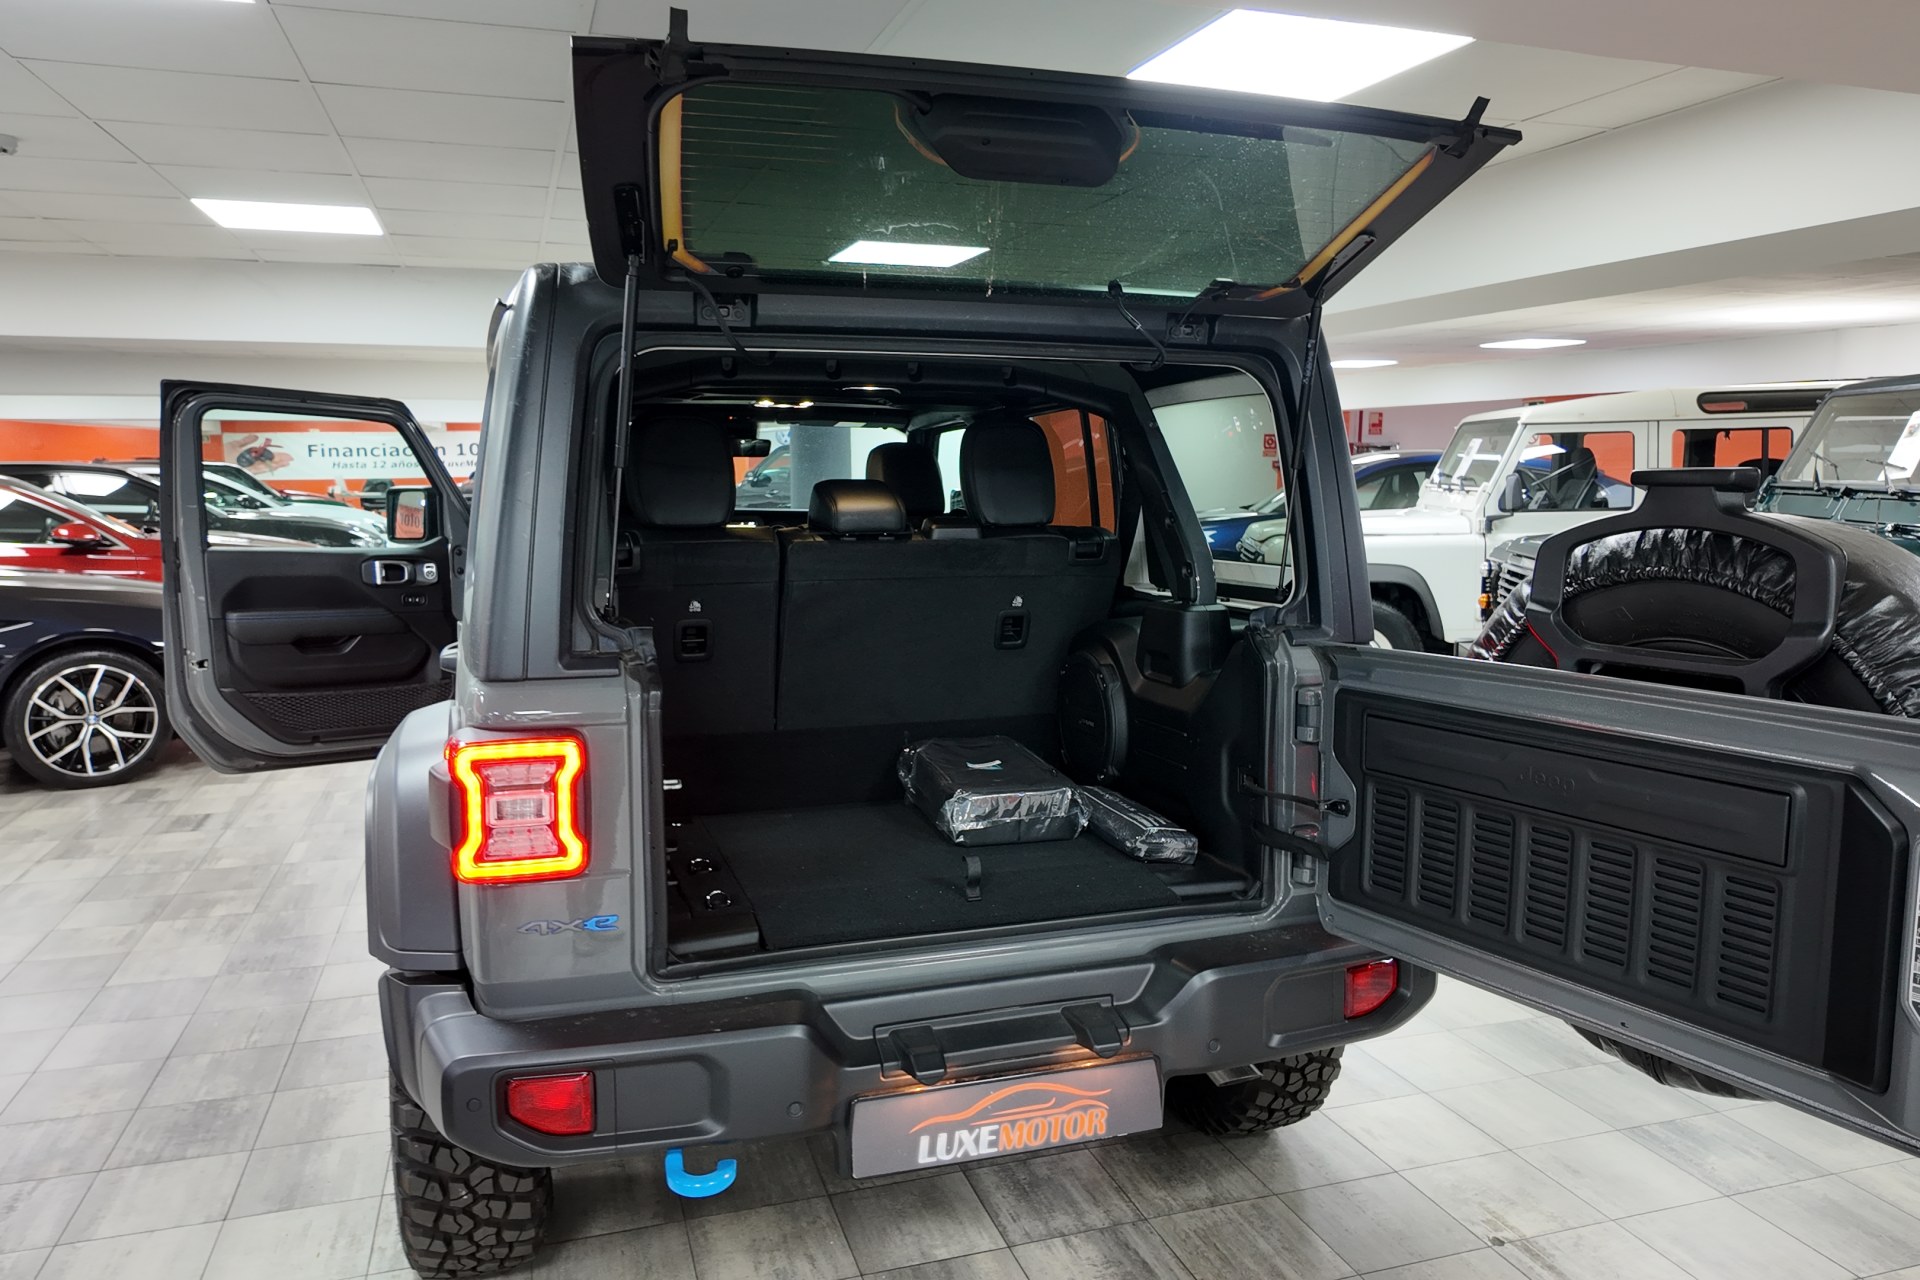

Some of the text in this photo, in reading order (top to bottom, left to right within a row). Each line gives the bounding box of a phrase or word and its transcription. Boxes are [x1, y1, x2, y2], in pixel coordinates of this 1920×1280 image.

[308, 443, 446, 458] Financiacn
[332, 460, 478, 469] Hasta 12 años uxeM
[918, 1108, 1108, 1164] LUXEMOTOR
